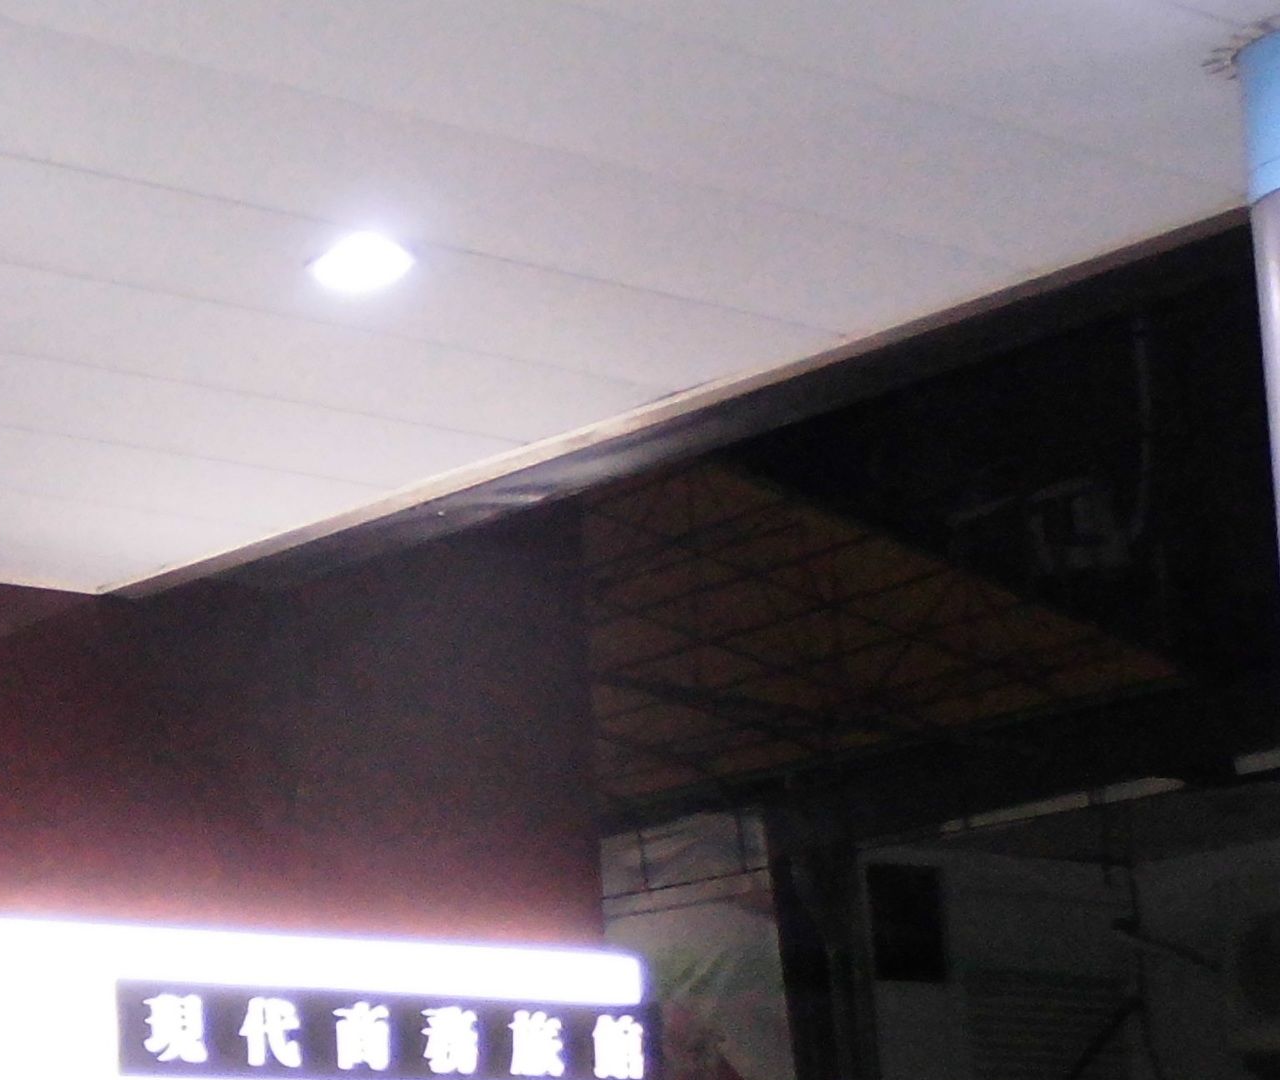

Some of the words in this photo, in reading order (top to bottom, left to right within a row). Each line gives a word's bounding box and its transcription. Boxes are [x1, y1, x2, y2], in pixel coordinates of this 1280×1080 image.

[143, 993, 644, 1079] 現代商務旅館
